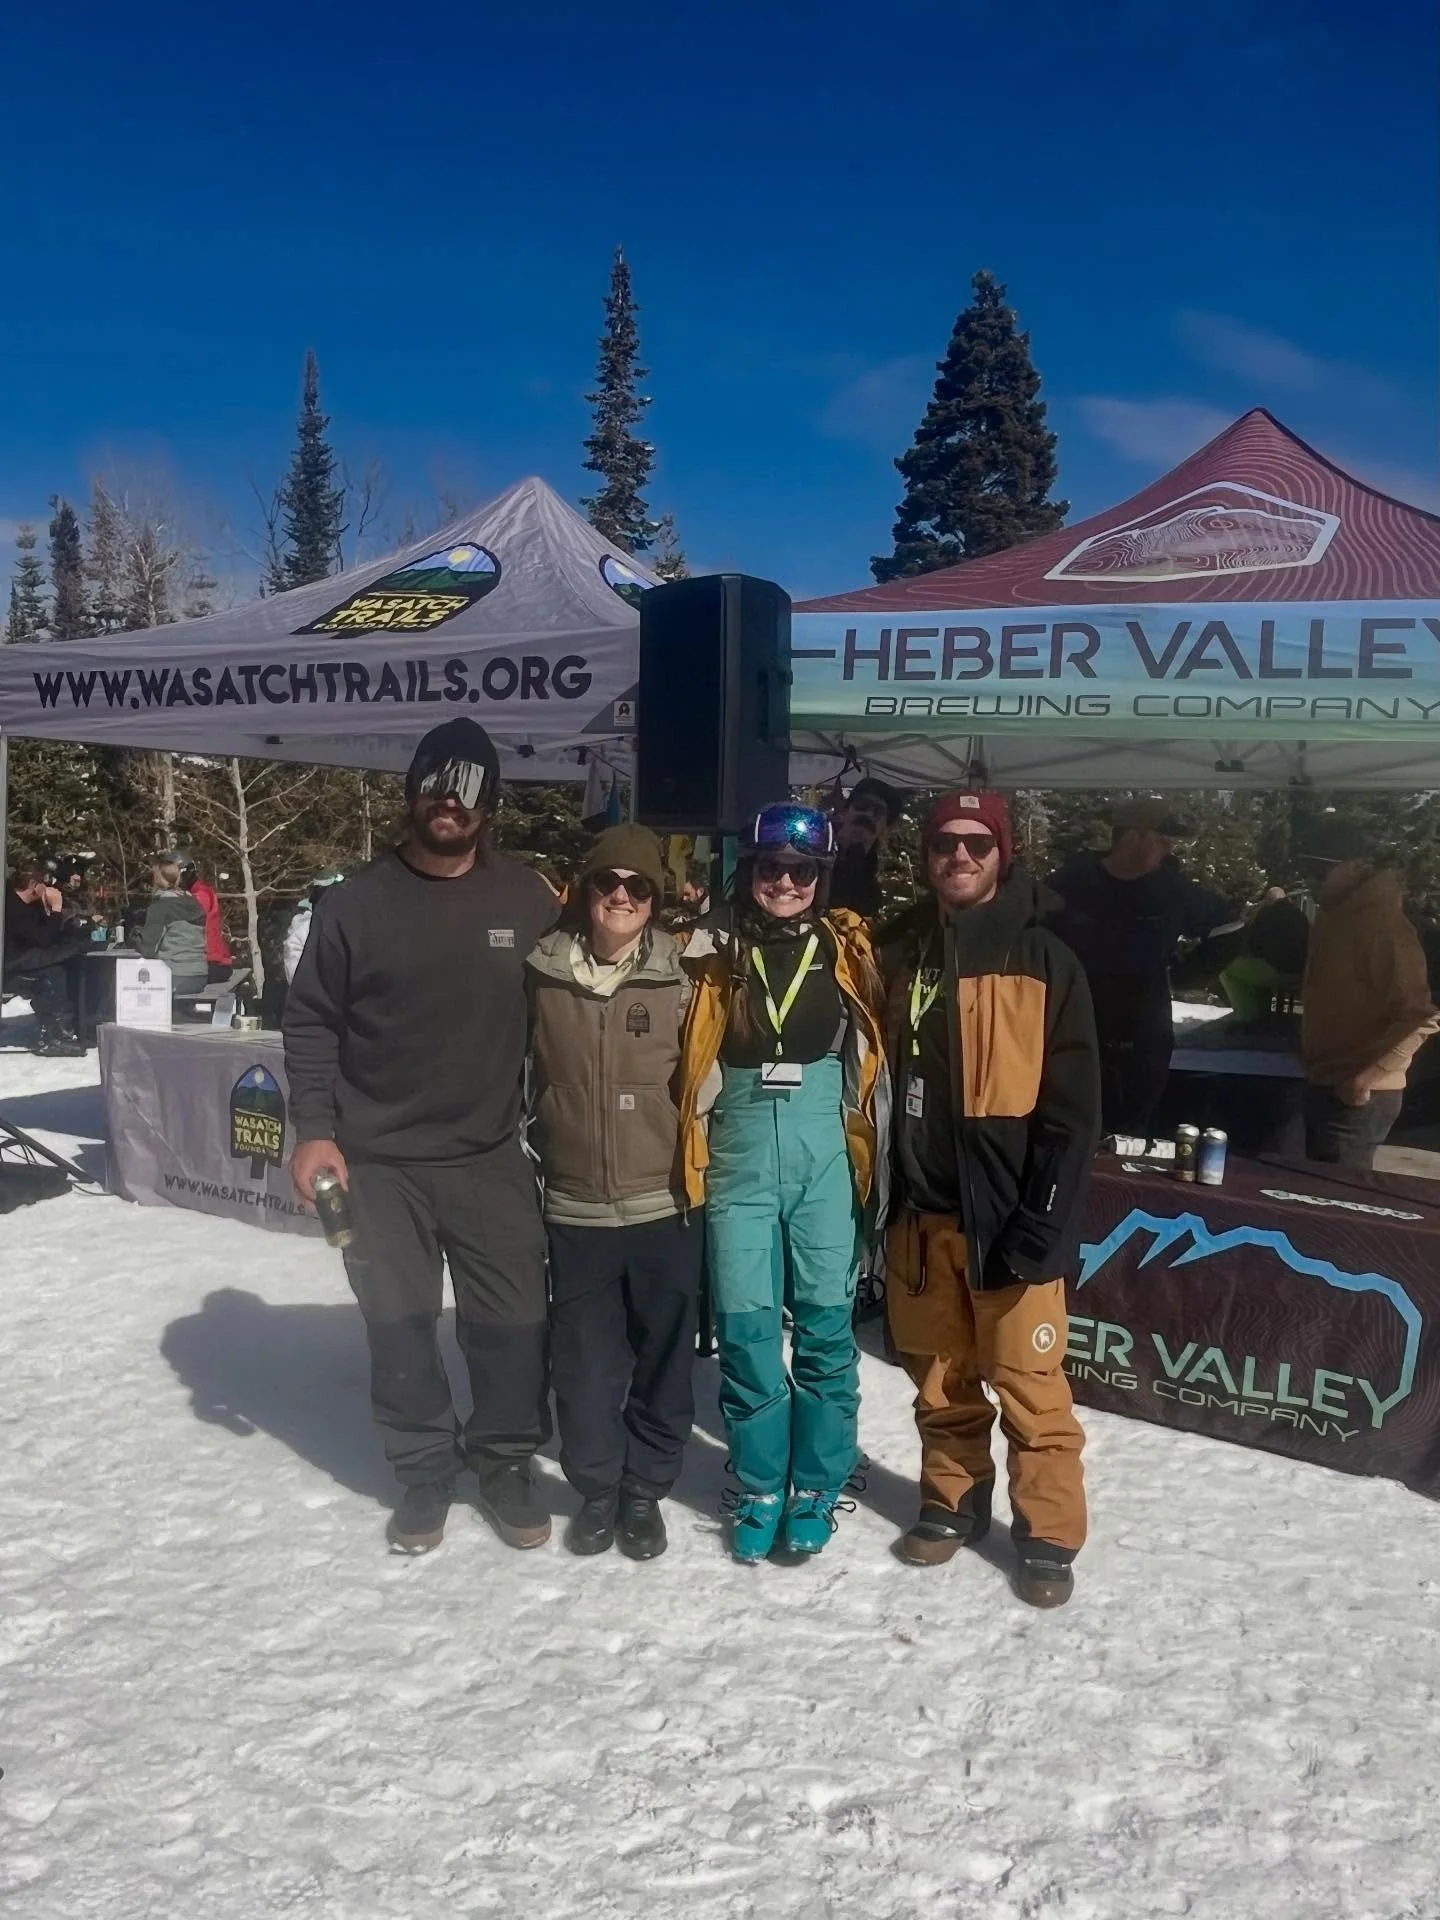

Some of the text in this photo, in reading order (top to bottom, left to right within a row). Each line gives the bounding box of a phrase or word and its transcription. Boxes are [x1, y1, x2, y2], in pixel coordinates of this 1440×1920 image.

[330, 610, 449, 623] TRAILS
[350, 598, 469, 610] WASATCH
[842, 621, 1101, 681] HEBER
[32, 654, 593, 709] WWW.WASATCHTRAILS.ORG
[864, 694, 1440, 720] BREWING COMPANY
[235, 1115, 281, 1134] WASATCH
[1151, 1333, 1404, 1429] VALLEY
[1152, 1380, 1360, 1442] COMPANY
